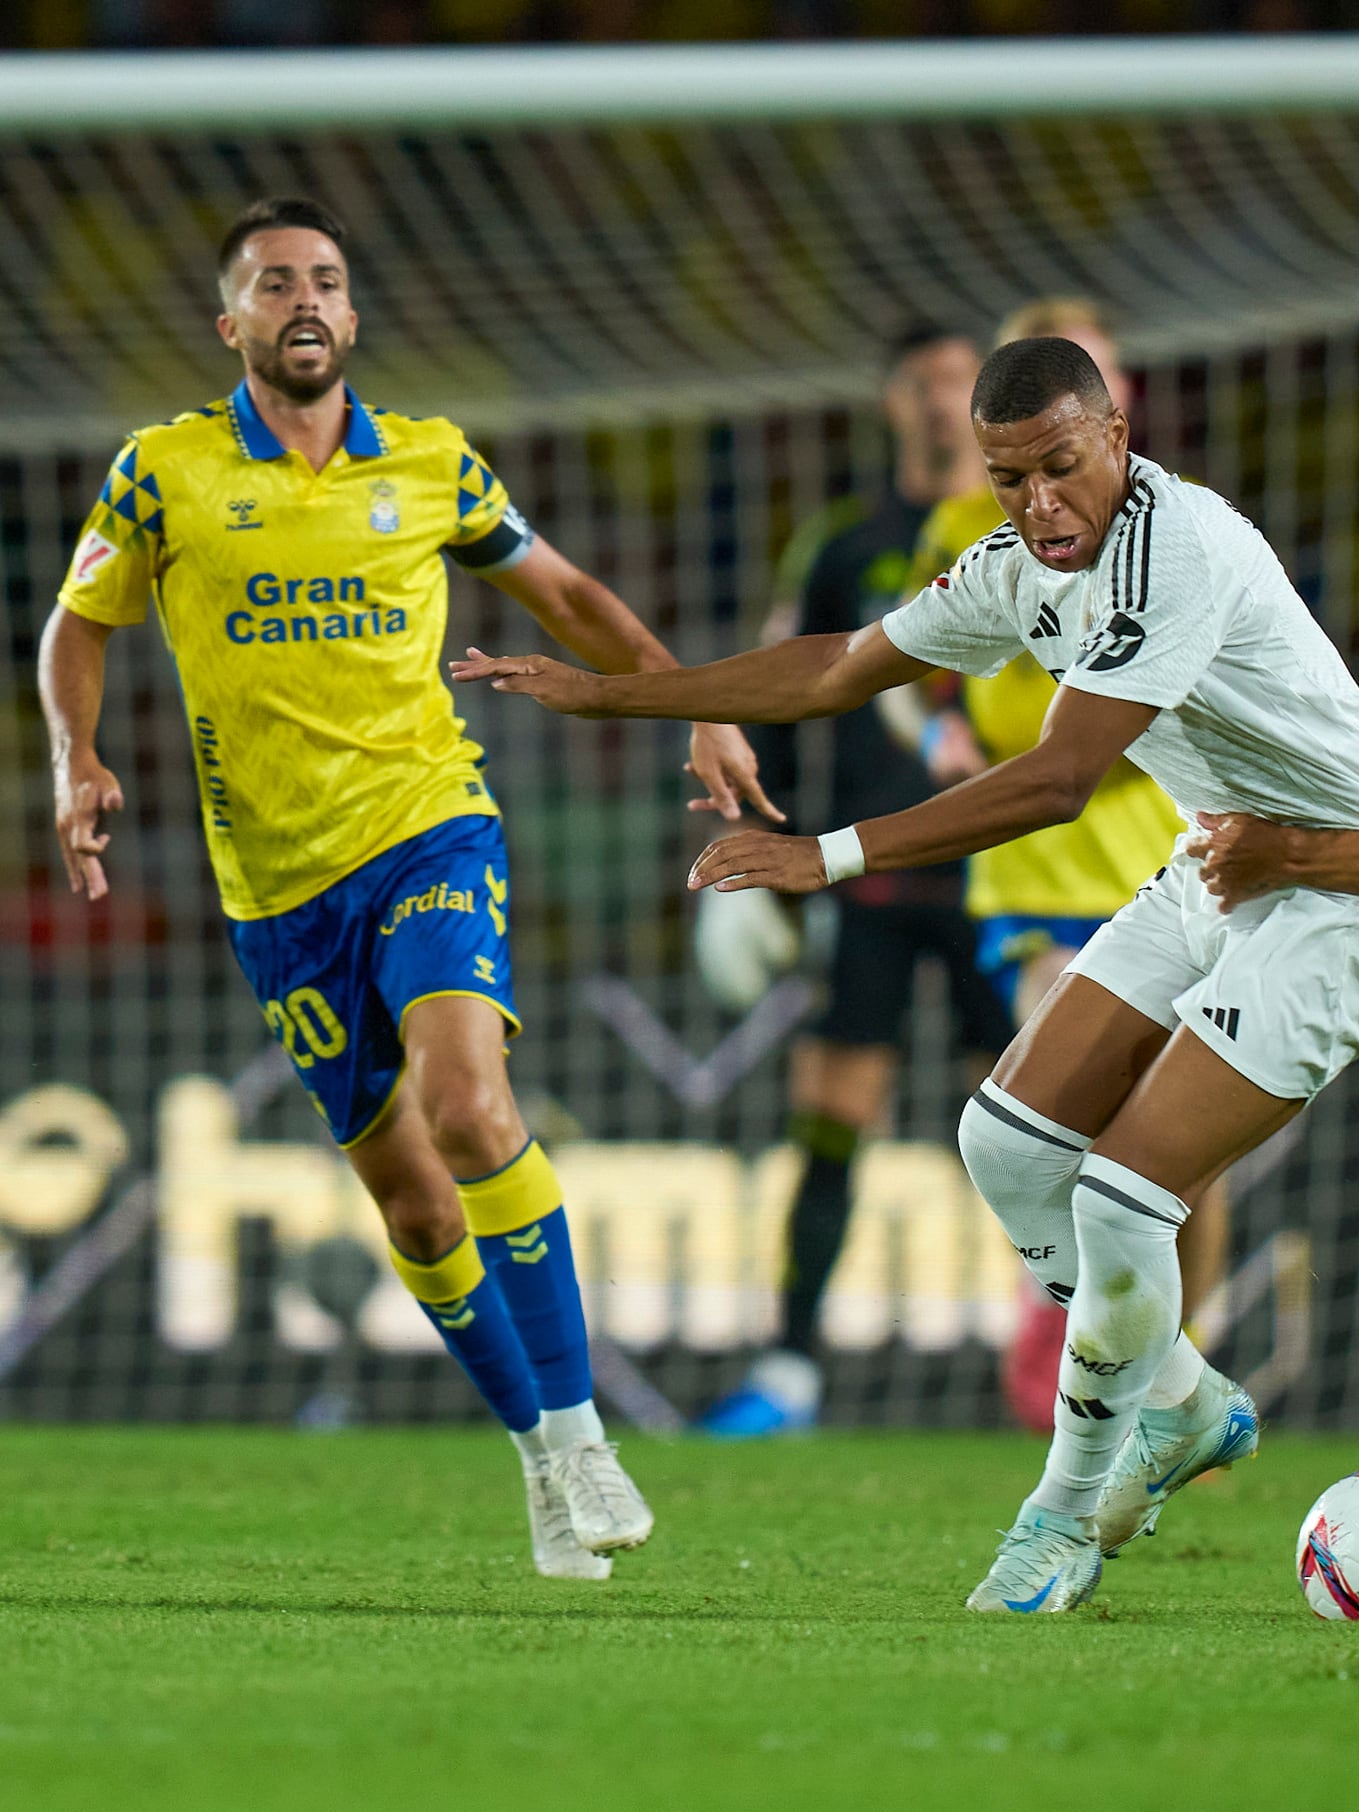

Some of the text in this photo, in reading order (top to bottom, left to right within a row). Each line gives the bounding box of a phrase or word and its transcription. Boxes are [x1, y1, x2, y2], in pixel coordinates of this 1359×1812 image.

[246, 573, 365, 607] Gran
[226, 603, 406, 645] Canaria
[260, 986, 348, 1069] 20
